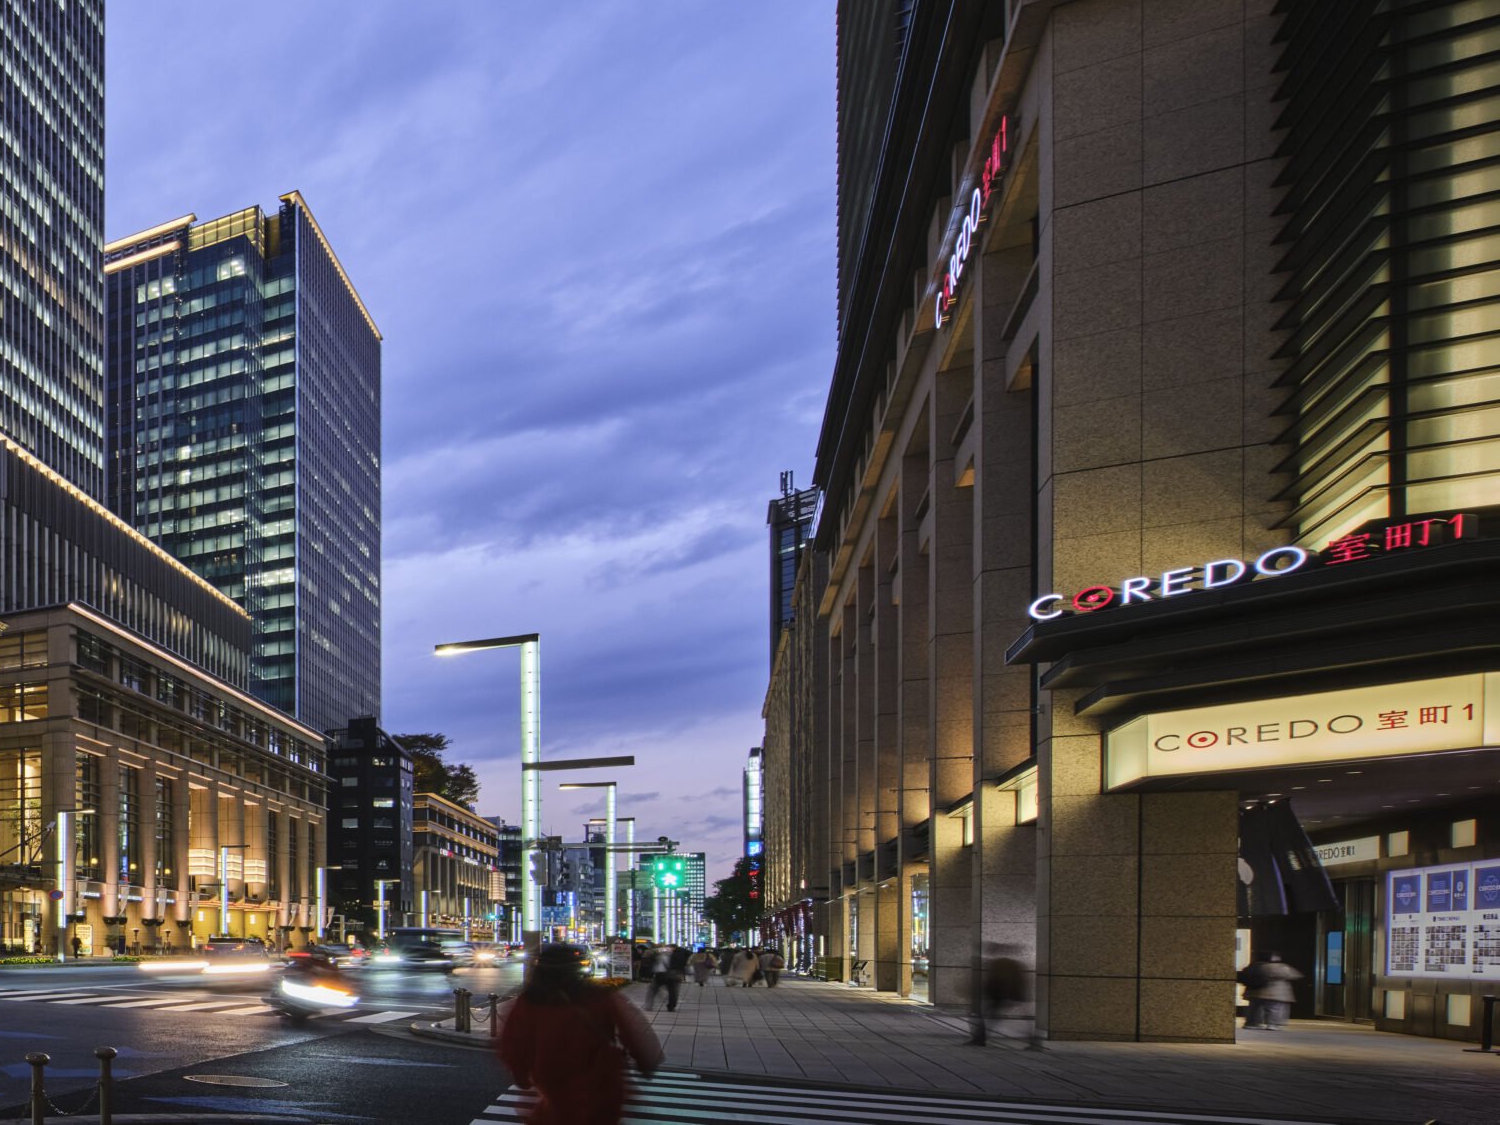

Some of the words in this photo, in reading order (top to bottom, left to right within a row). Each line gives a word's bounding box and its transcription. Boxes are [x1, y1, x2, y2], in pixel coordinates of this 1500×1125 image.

[935, 187, 981, 329] COREDO
[1028, 546, 1307, 620] COREDO
[1154, 714, 1364, 752] COREDO
